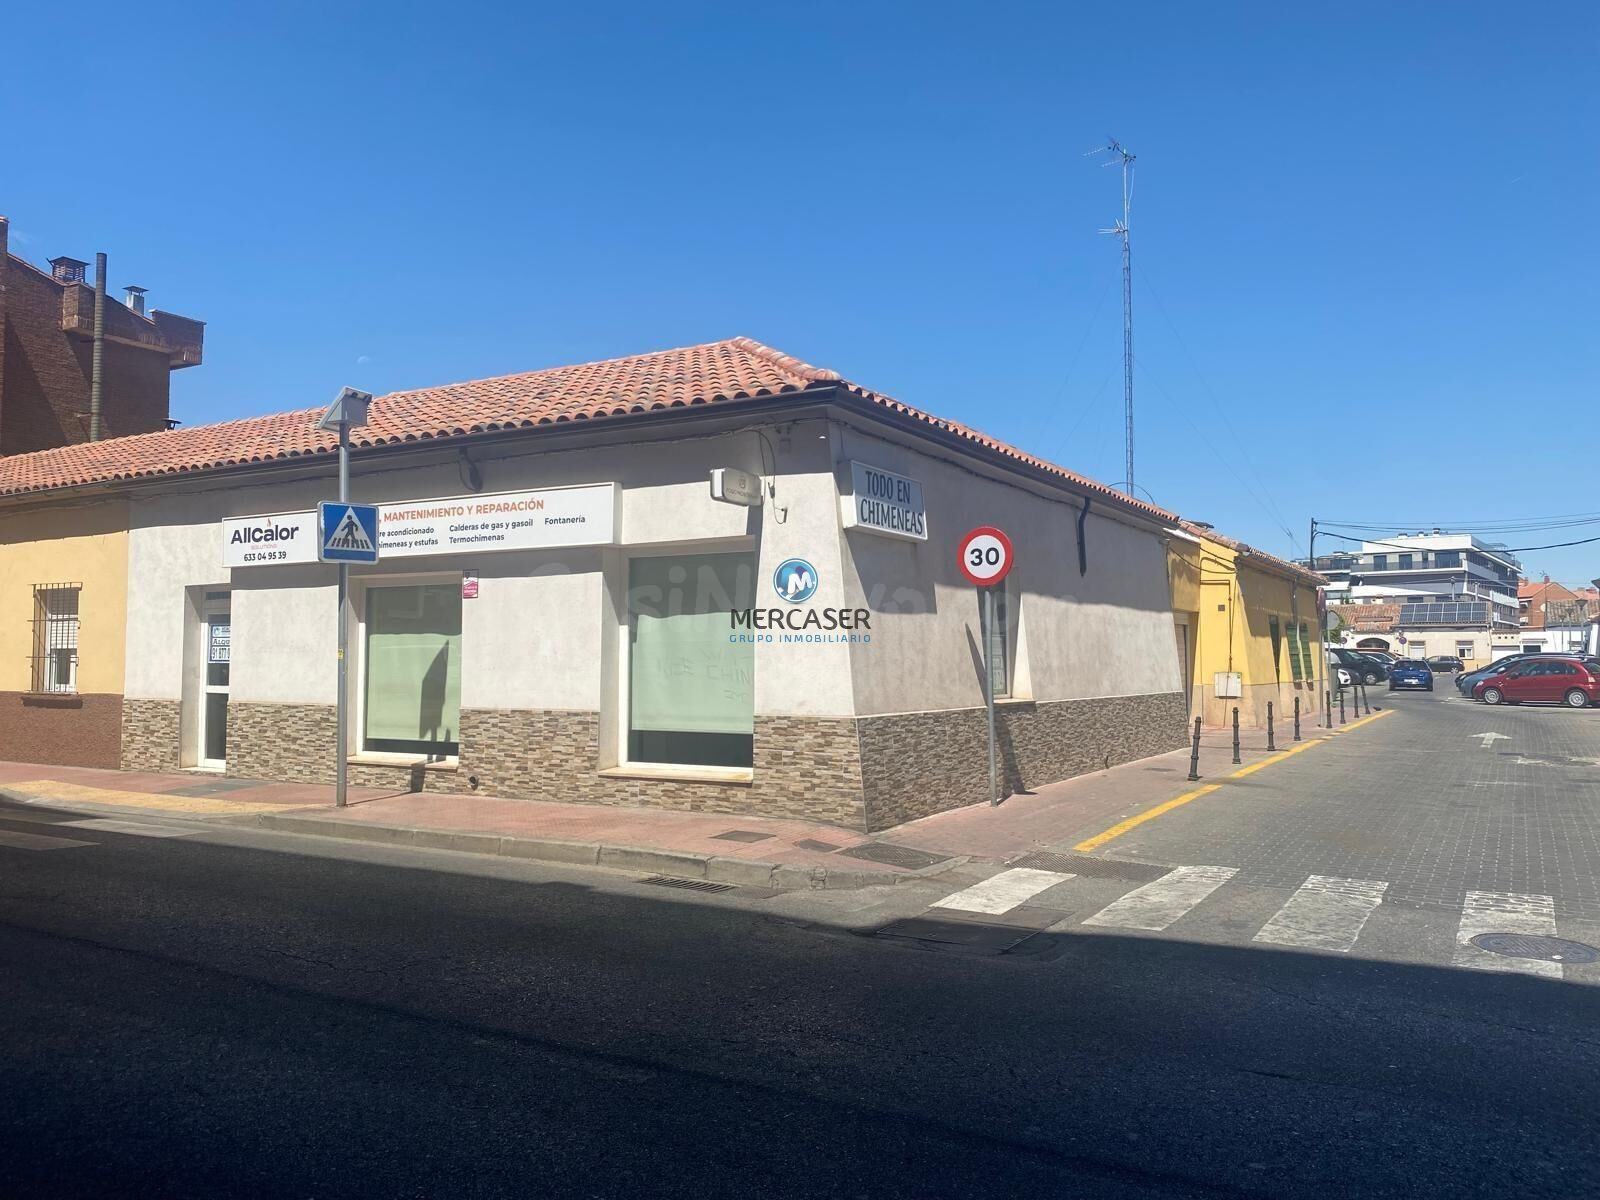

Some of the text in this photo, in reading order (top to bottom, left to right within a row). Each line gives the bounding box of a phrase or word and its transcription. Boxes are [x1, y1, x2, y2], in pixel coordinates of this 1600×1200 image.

[865, 470, 911, 504] TODO EN
[383, 498, 544, 522] MANTENIMIENTO Y REPARACIÓN
[860, 498, 923, 535] CHIMENEAS
[449, 519, 534, 532] Calderas de gas y gasoil
[544, 515, 586, 525] Fontanería
[230, 524, 299, 544] AllCalor
[386, 527, 434, 537] acondicionado
[408, 540, 413, 549] y
[414, 538, 439, 547] estufas
[449, 534, 505, 544] Termochimenas
[243, 550, 287, 561] 633 04 95 39
[970, 547, 1000, 567] 30
